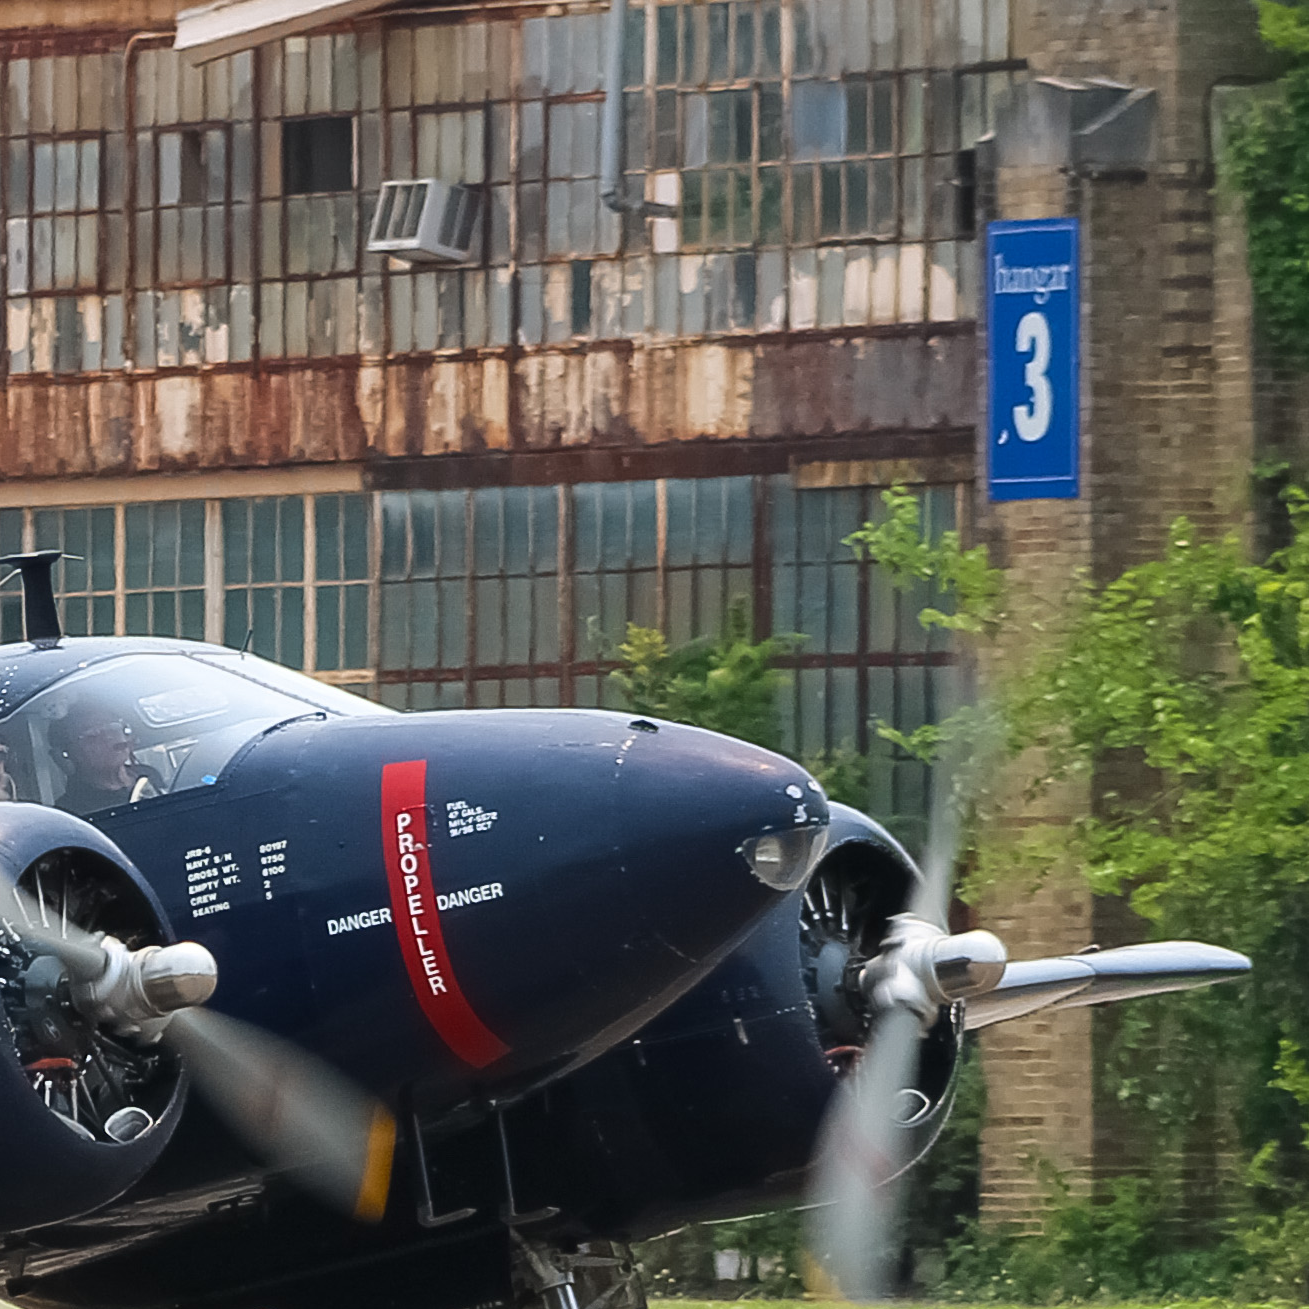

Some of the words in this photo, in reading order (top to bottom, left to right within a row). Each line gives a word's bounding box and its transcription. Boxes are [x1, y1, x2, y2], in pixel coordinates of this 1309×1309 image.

[994, 254, 1070, 304] hangar
[1013, 312, 1052, 441] 3
[185, 846, 211, 860] JRB-6
[186, 858, 210, 871] NAVY
[213, 853, 232, 864] S/N
[187, 868, 218, 882] GROSS
[222, 863, 240, 873] WT.
[188, 879, 220, 895] EMPTY
[223, 875, 241, 885] WT.
[190, 893, 217, 906] CREW
[263, 880, 271, 889] 2
[192, 902, 230, 918] SEATING
[265, 891, 273, 900] 5
[396, 813, 447, 996] PROPELLER
[436, 882, 504, 911] DANGER
[327, 907, 392, 935] DANGER
